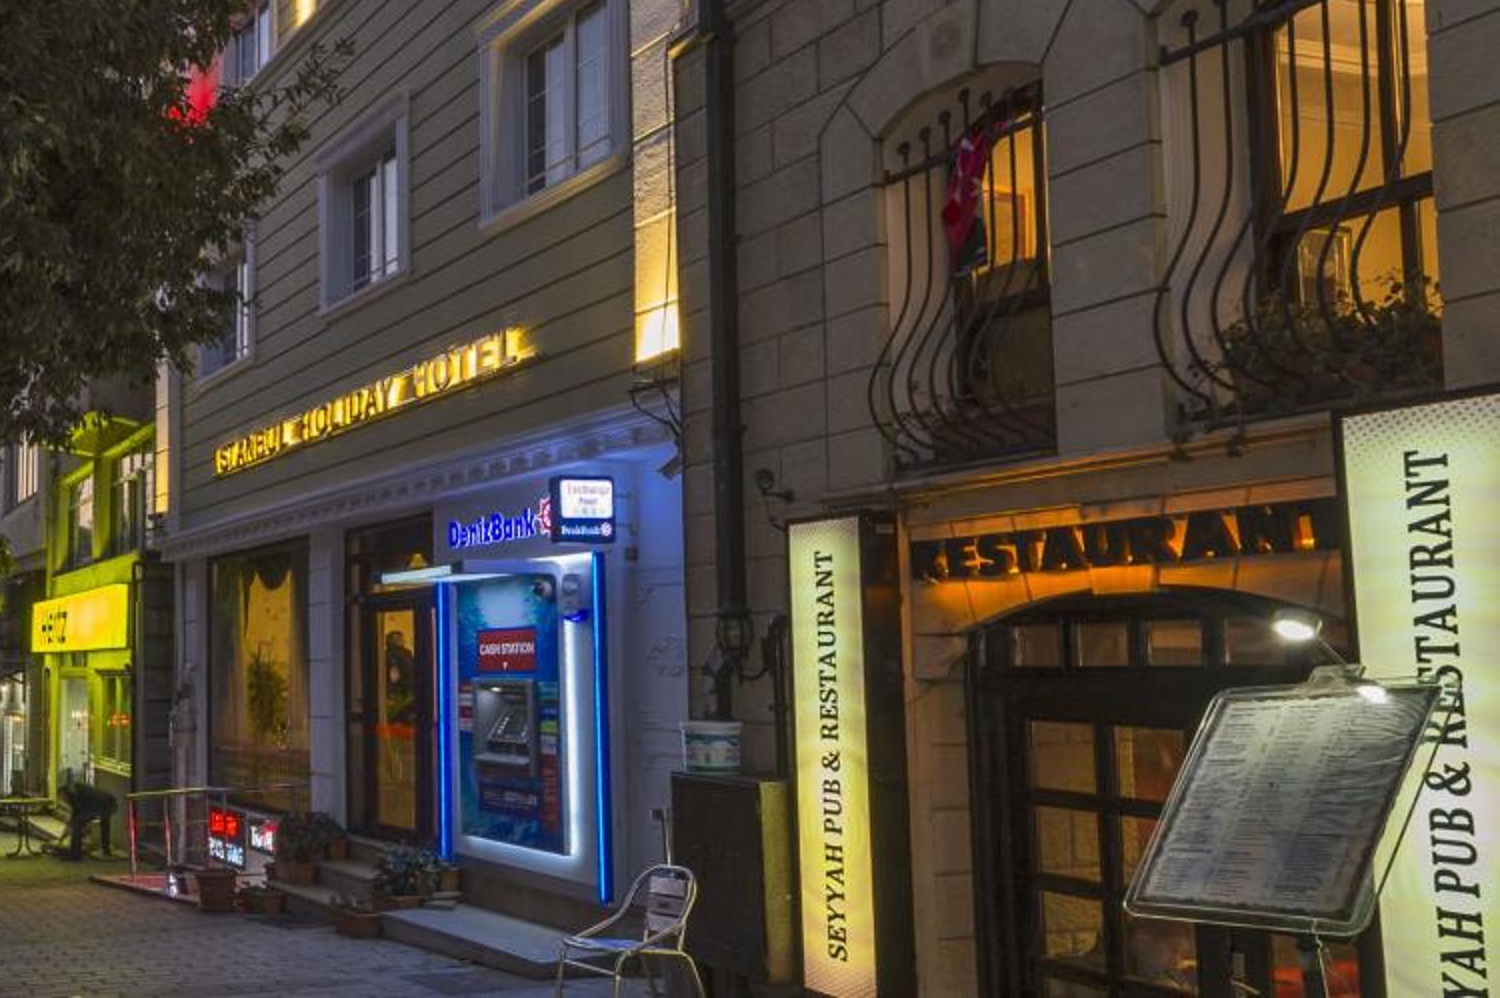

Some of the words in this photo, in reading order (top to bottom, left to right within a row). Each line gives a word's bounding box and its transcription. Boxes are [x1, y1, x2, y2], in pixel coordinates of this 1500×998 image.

[410, 325, 534, 396] HOTEL
[448, 508, 537, 548] DenizBank
[479, 643, 501, 655] CASH
[501, 641, 536, 654] STATION
[814, 551, 840, 740] RESTAURANT
[821, 751, 841, 771] &
[1423, 761, 1472, 796] &
[823, 779, 843, 835] PUB
[1429, 807, 1481, 898] PUB
[825, 845, 848, 962] SEYYAH
